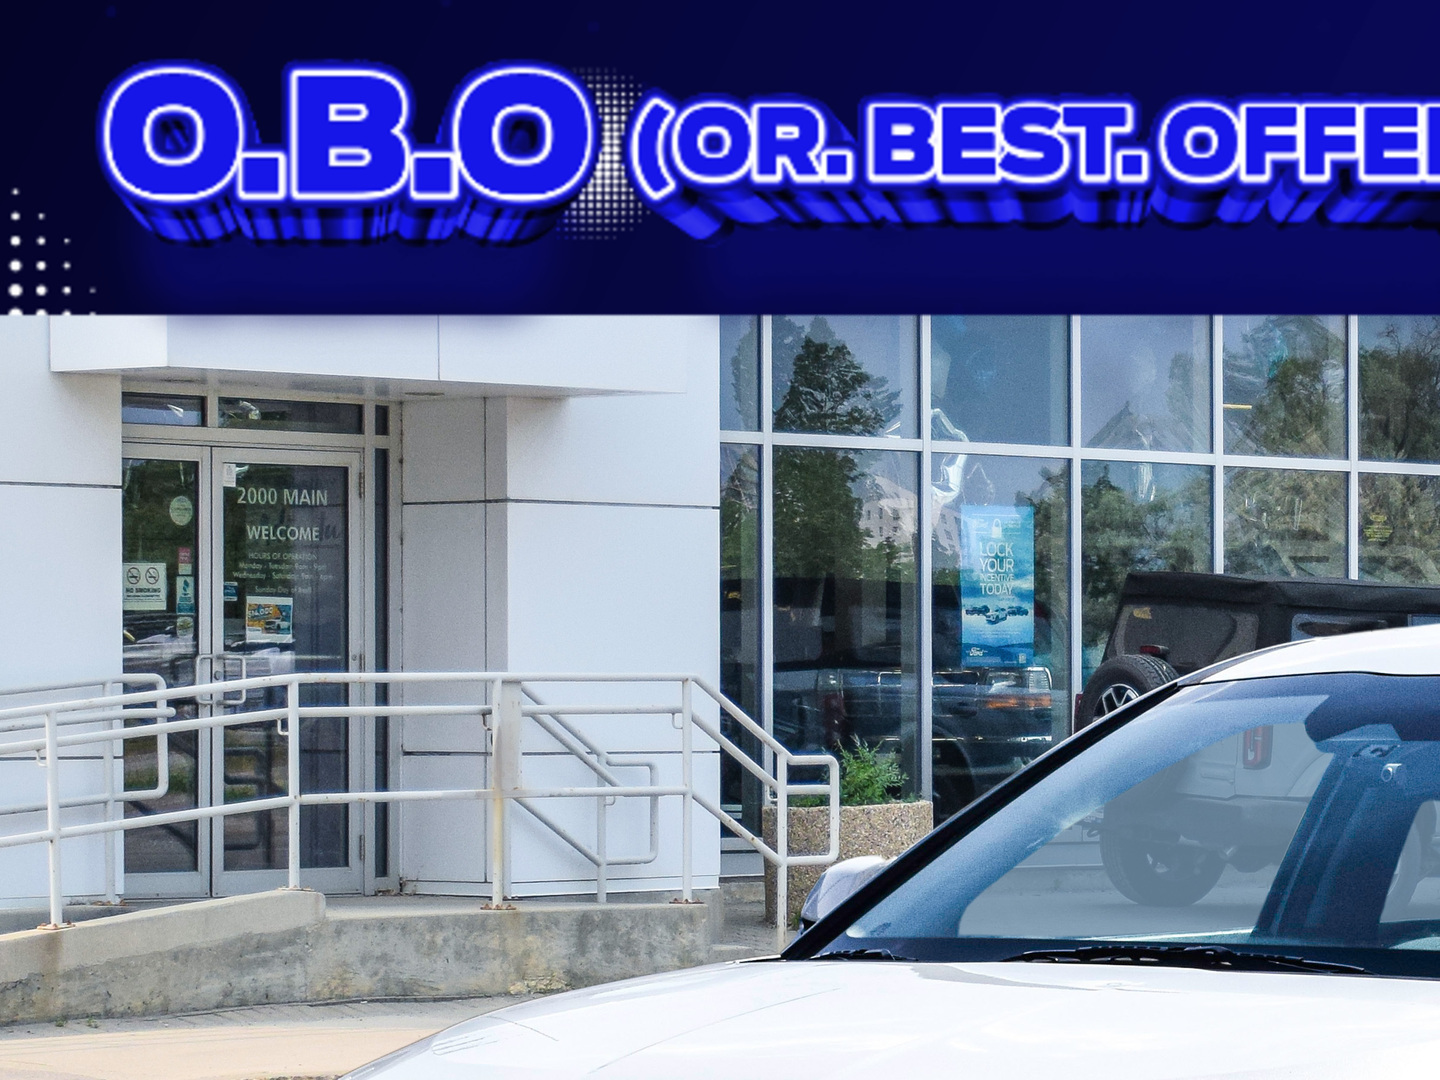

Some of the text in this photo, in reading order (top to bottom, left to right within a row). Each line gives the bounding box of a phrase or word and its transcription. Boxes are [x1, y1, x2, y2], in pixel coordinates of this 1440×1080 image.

[236, 487, 328, 506] 2000 MAIN
[245, 524, 320, 541] WELCOME
[248, 552, 270, 560] HOURS
[980, 541, 1014, 557] LOCK
[980, 558, 1014, 572] YOUR
[980, 583, 1014, 595] TODAY
